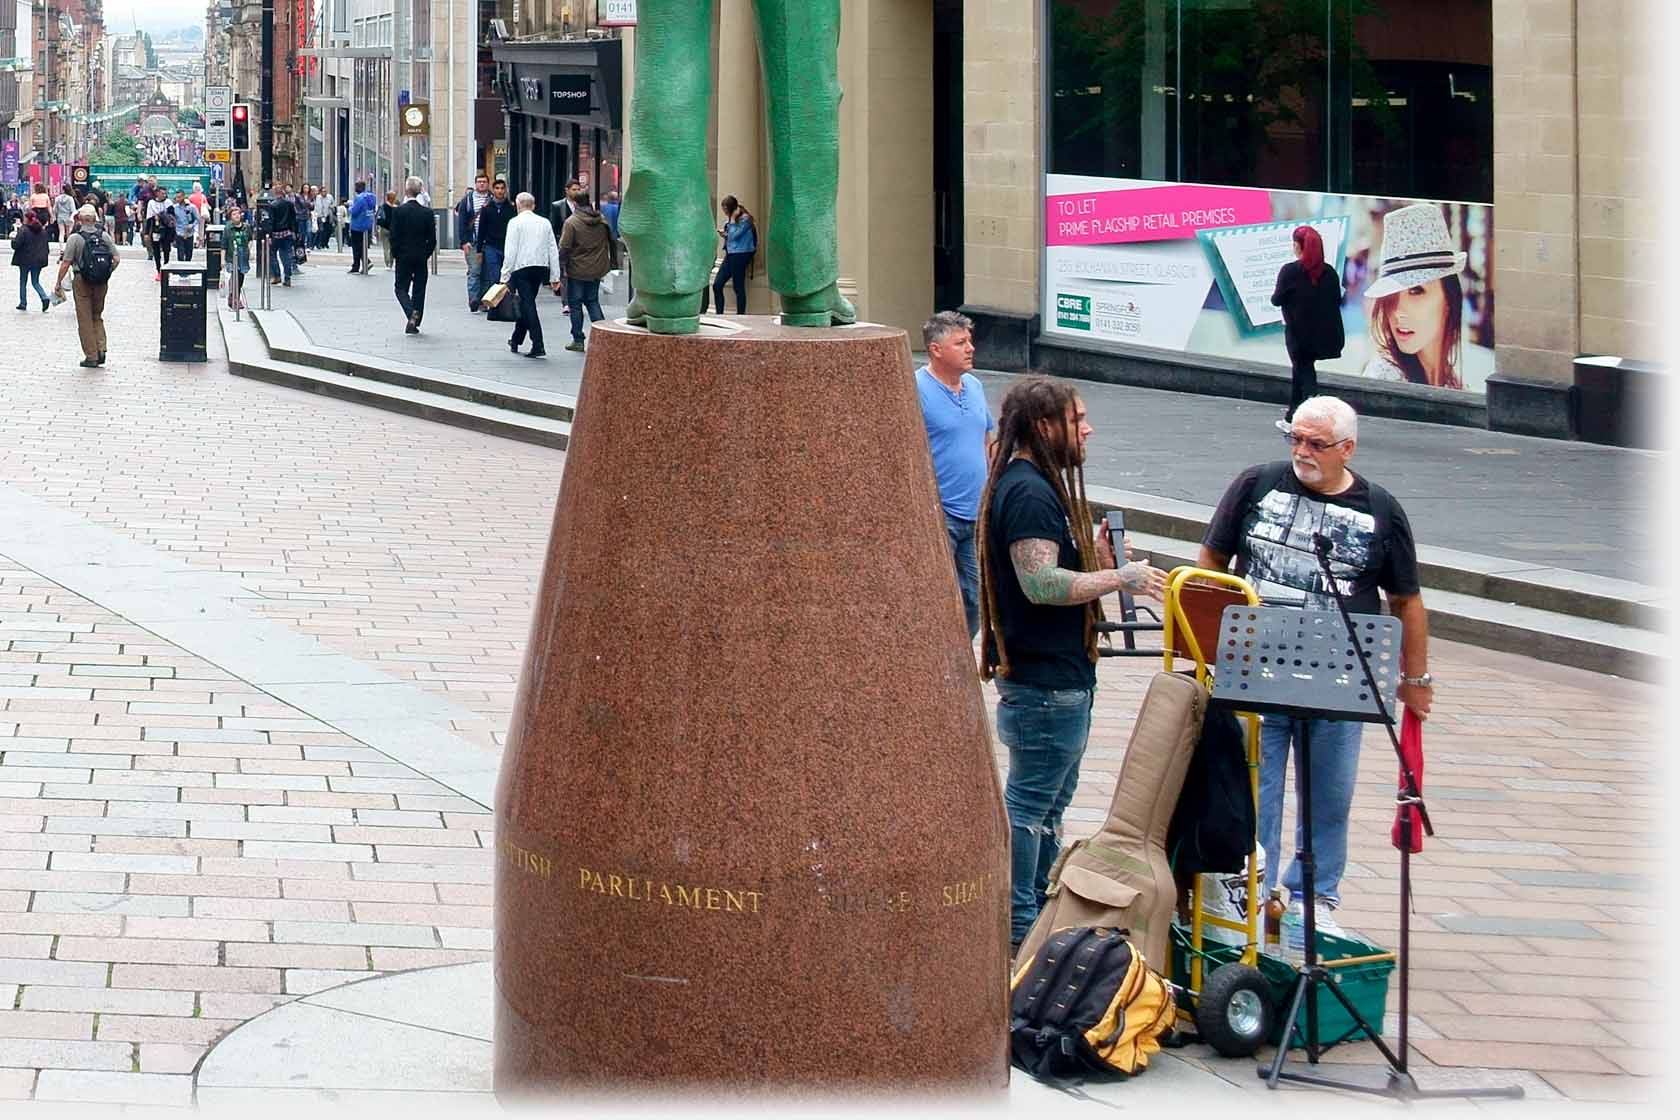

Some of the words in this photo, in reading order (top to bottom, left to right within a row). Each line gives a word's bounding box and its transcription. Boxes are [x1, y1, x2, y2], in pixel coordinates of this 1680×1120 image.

[552, 91, 588, 99] TOPSHOP
[1057, 201, 1075, 216] TO
[1078, 199, 1096, 214] LET
[1059, 221, 1088, 237] PRIME
[1091, 217, 1139, 234] FLAGSHIP
[1144, 214, 1178, 229] RETAIL
[1182, 208, 1236, 226] PREMISES
[1058, 297, 1082, 311] CBRE
[1252, 521, 1282, 540] NEW
[578, 867, 764, 914] PARLIAMENT
